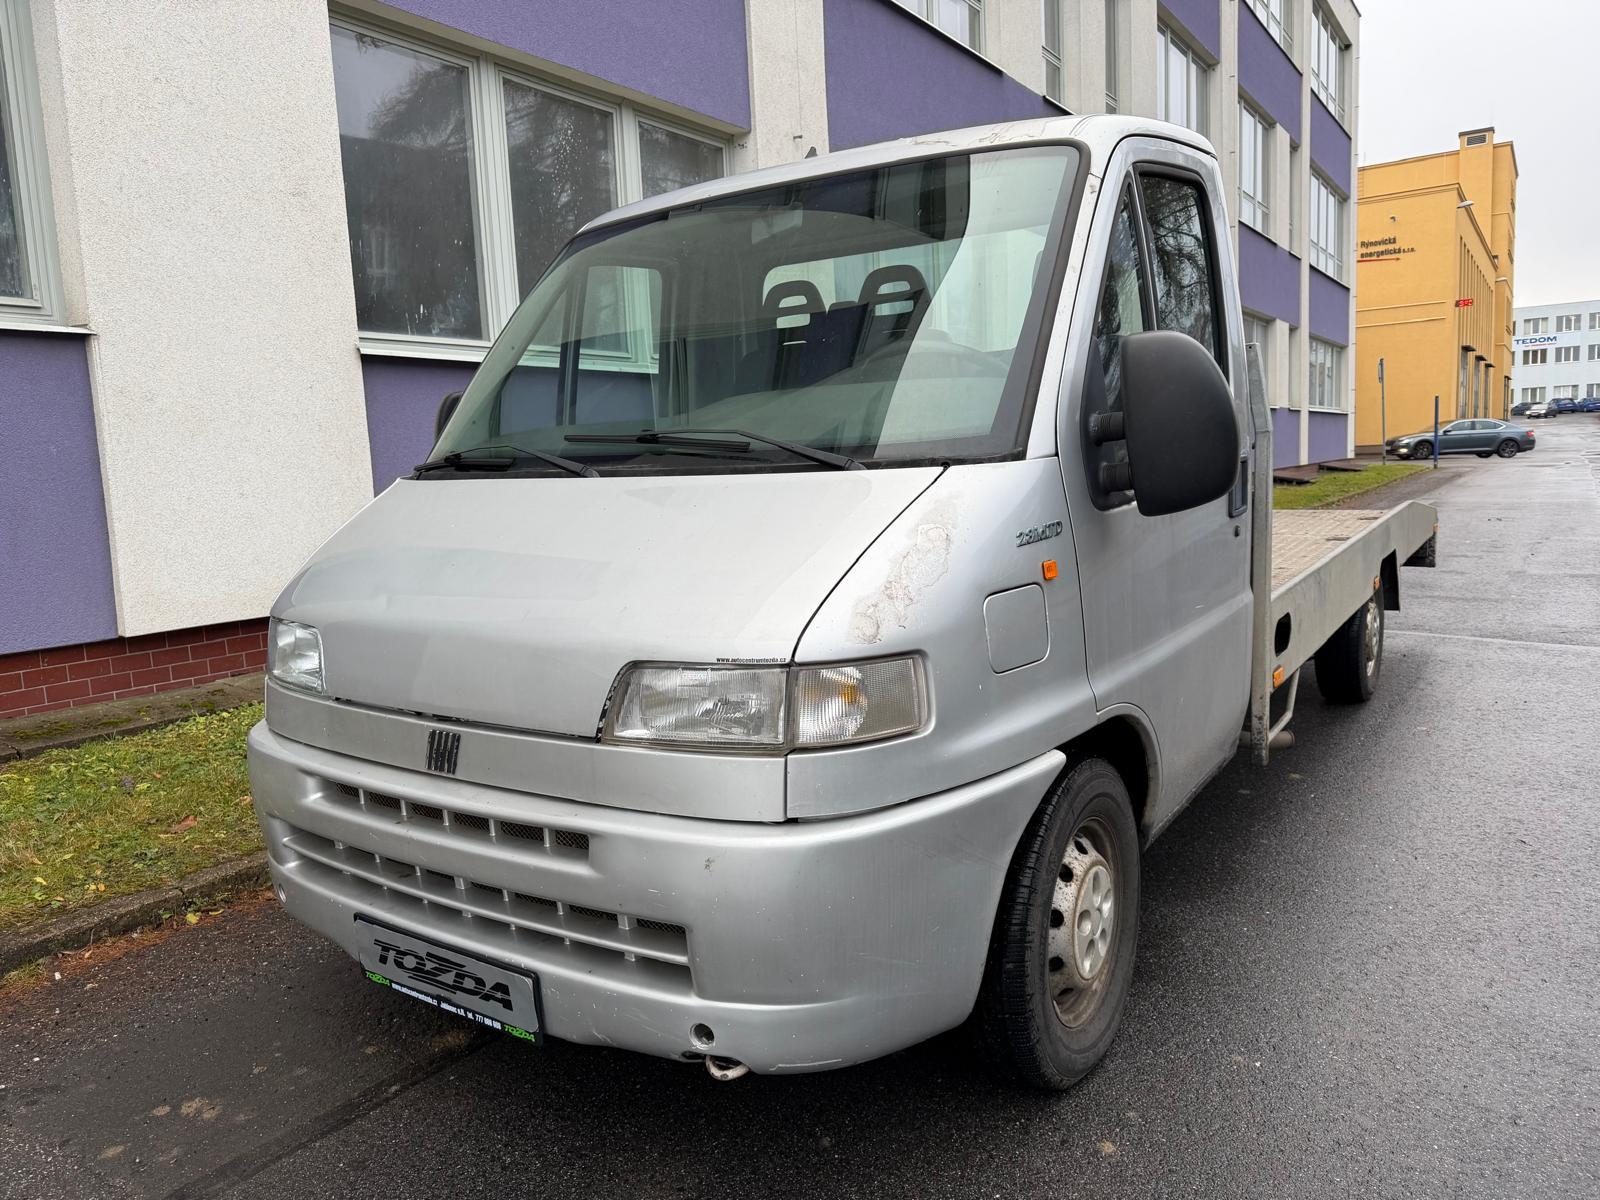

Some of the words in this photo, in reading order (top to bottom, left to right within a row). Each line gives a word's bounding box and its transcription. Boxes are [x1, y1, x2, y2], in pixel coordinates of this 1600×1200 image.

[1360, 247, 1402, 259] energetická
[1514, 336, 1557, 345] TEDOM
[365, 971, 391, 986] TOZDA
[373, 938, 513, 1012] TOZDA
[503, 1024, 536, 1043] TOZDA
